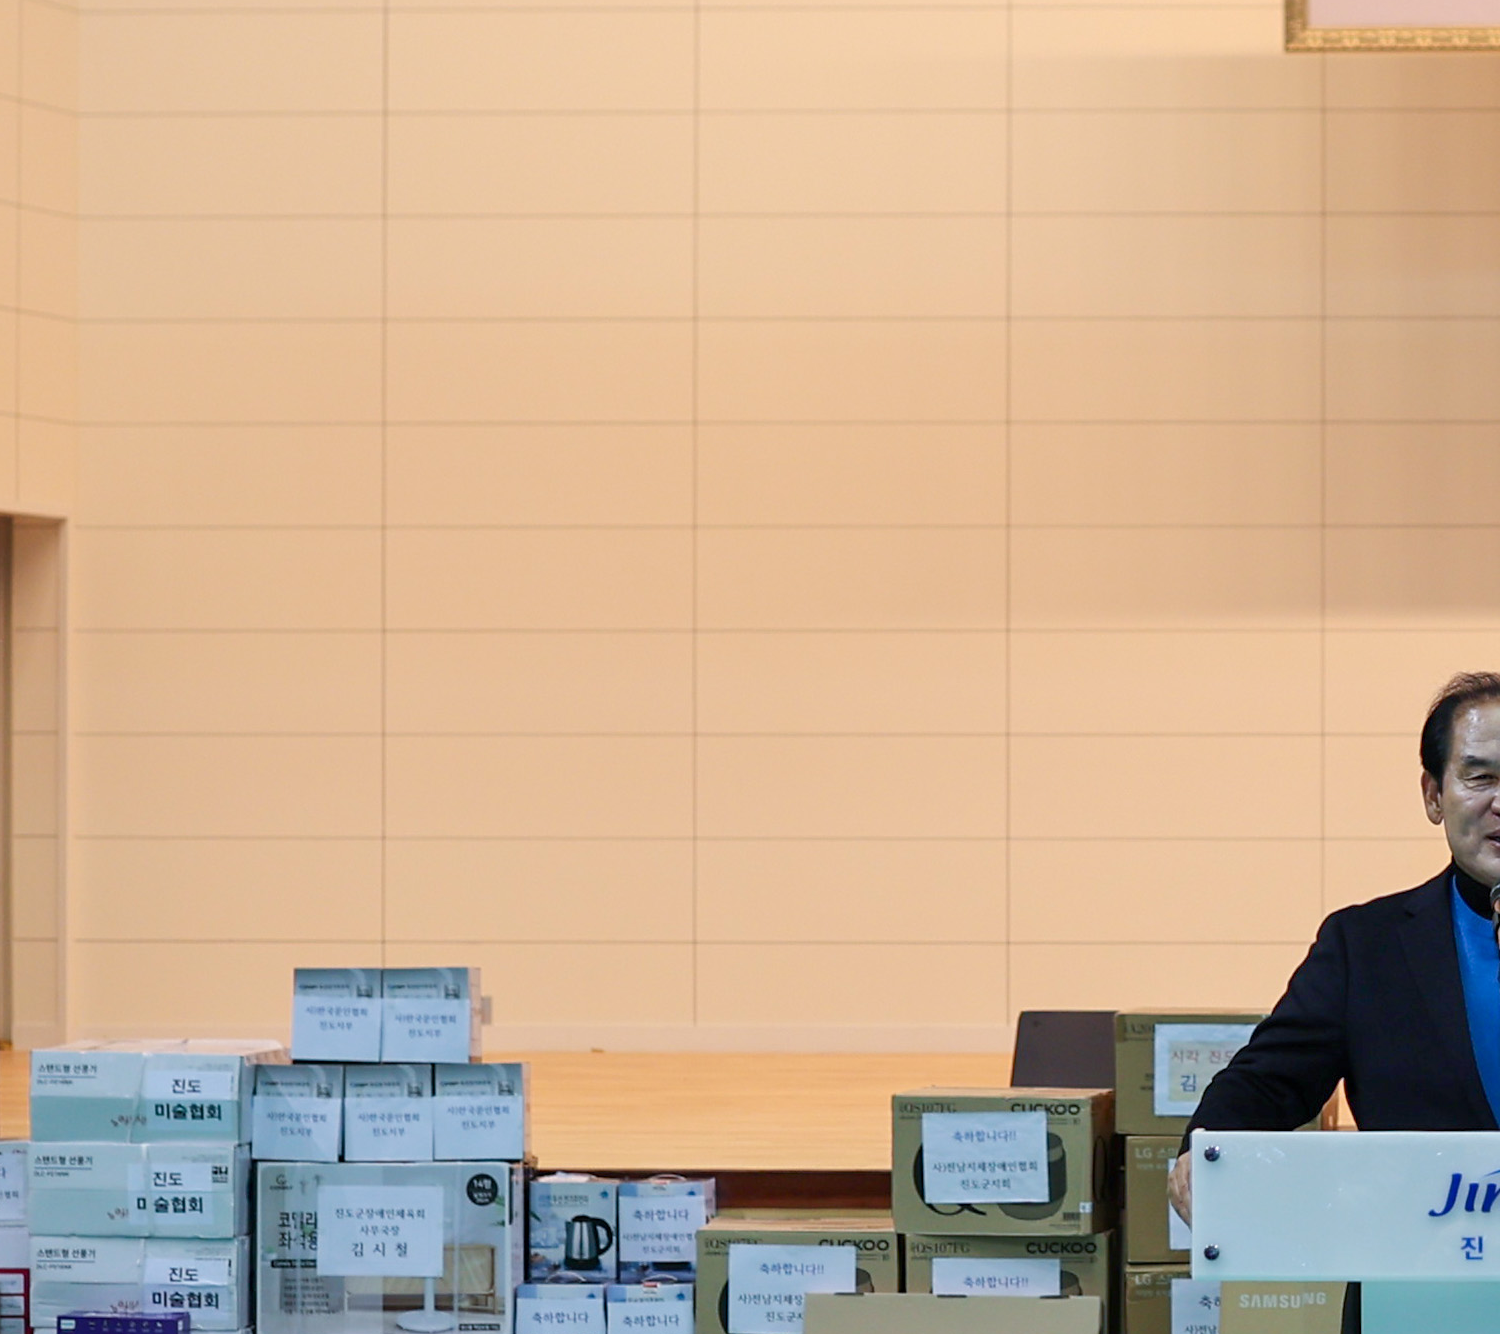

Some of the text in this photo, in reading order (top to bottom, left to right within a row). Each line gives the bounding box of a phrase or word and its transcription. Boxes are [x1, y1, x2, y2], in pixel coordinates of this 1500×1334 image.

[1209, 1050, 1235, 1064] 진도
[171, 1077, 202, 1095] 진도
[154, 1102, 222, 1122] 미술협회
[152, 1171, 183, 1188] 진도
[1025, 1241, 1097, 1255] CUCKOO
[168, 1267, 199, 1283] 진도
[152, 1290, 219, 1310] 미술협회
[1239, 1292, 1327, 1309] SAMSUNG
[765, 1312, 804, 1323] 진도군
